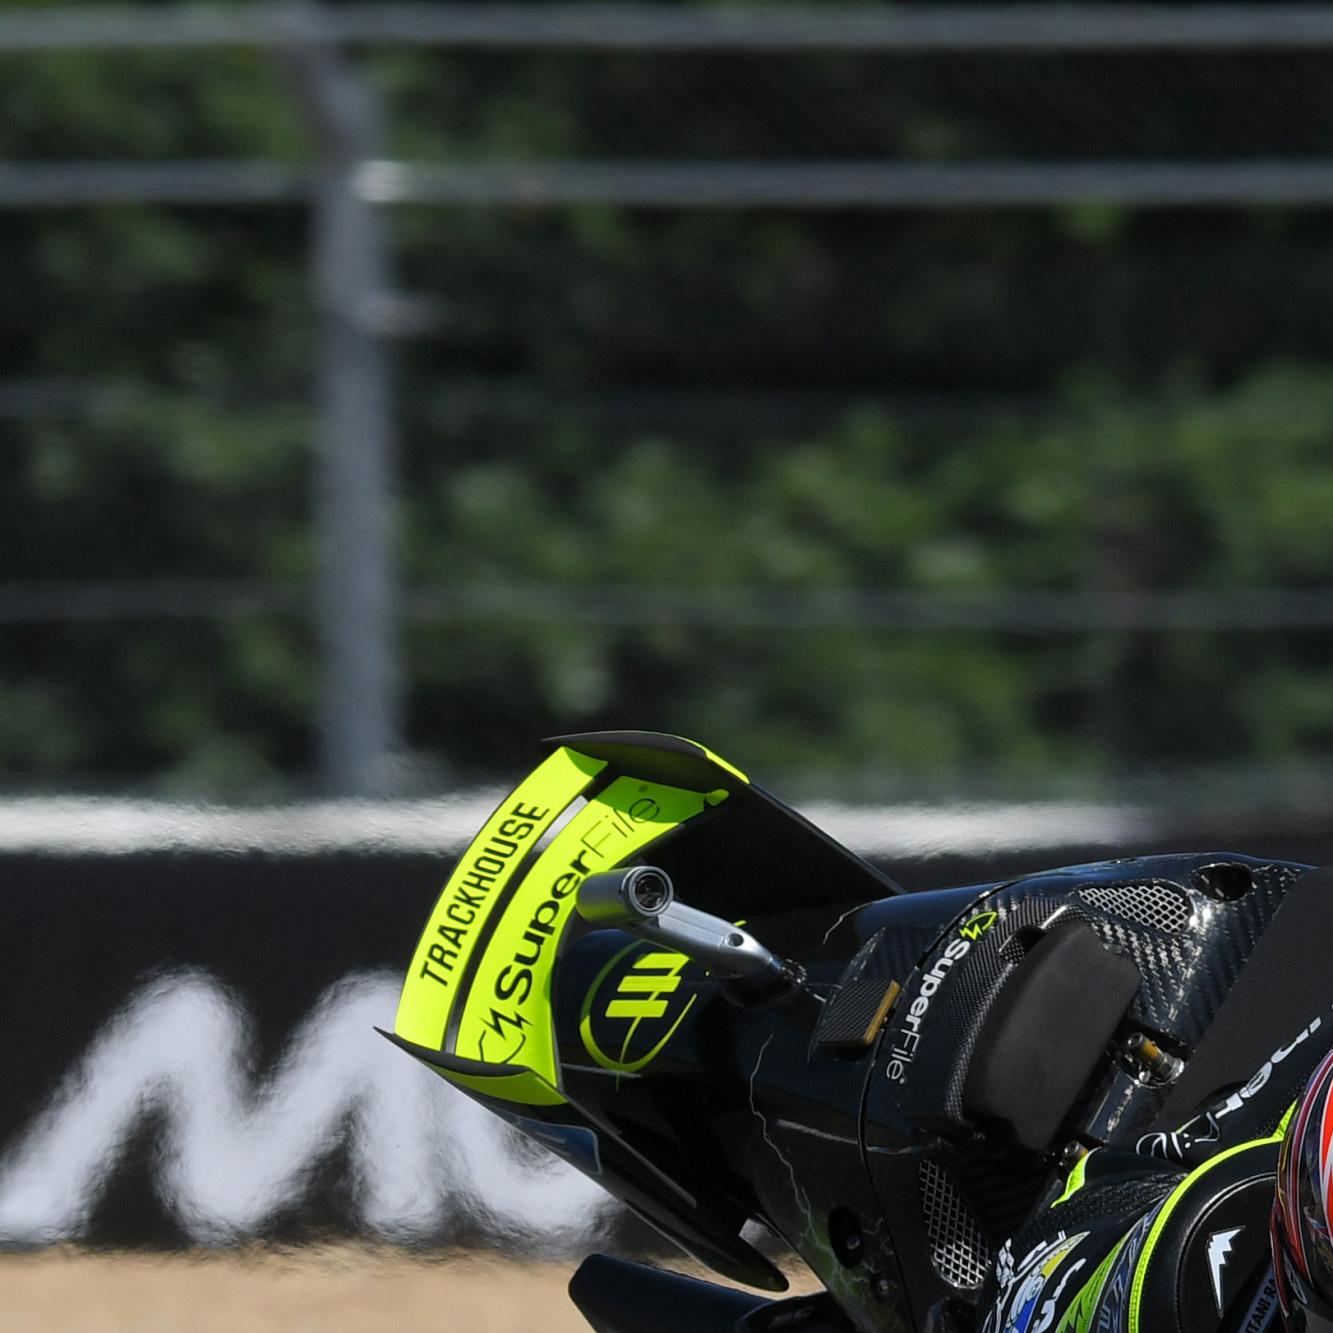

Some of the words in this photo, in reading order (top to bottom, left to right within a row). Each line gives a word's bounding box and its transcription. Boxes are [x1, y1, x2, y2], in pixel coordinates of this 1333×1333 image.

[420, 801, 549, 988] TRACKHOUSE
[499, 797, 661, 1006] SuperFile
[885, 936, 972, 1081] SuperFile
